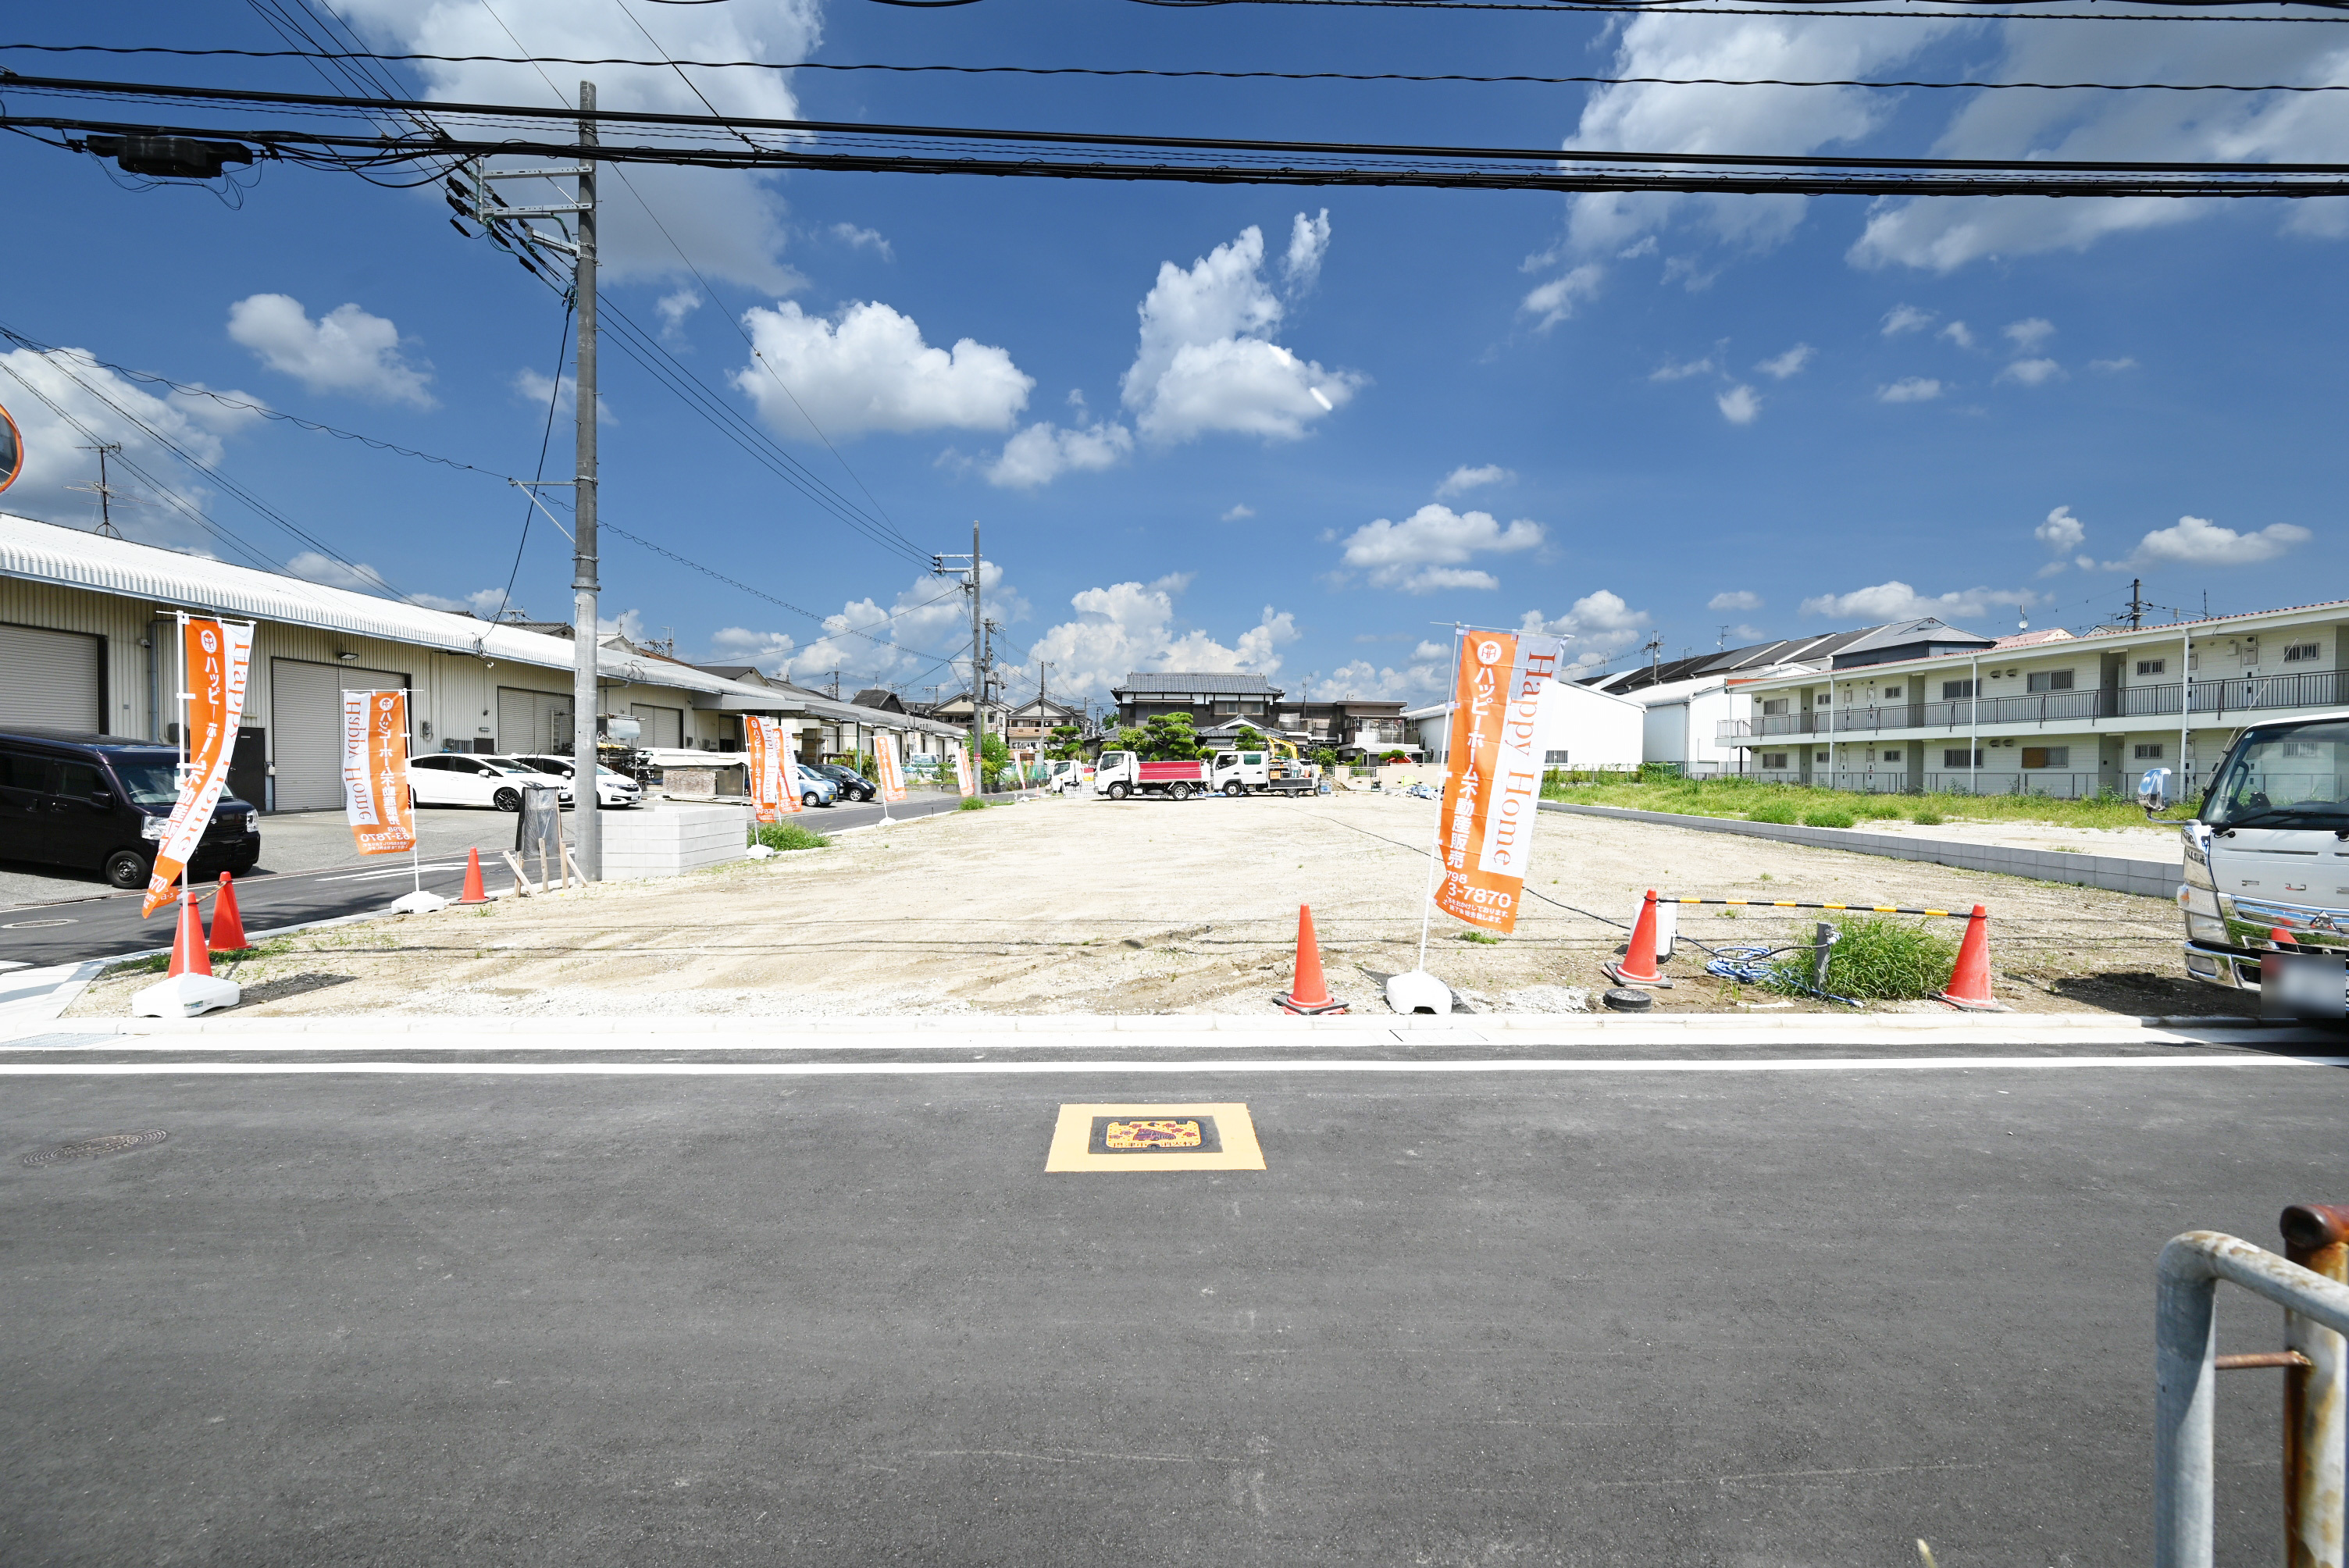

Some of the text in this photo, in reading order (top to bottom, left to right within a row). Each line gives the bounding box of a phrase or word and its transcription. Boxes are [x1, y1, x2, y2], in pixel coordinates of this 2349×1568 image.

[226, 641, 250, 744] Happy
[1446, 667, 1495, 869] ハッピーホーム不動産販売
[1493, 650, 1556, 866] Happy Home
[1447, 870, 1468, 884] 798
[1448, 882, 1512, 908] 3-7870
